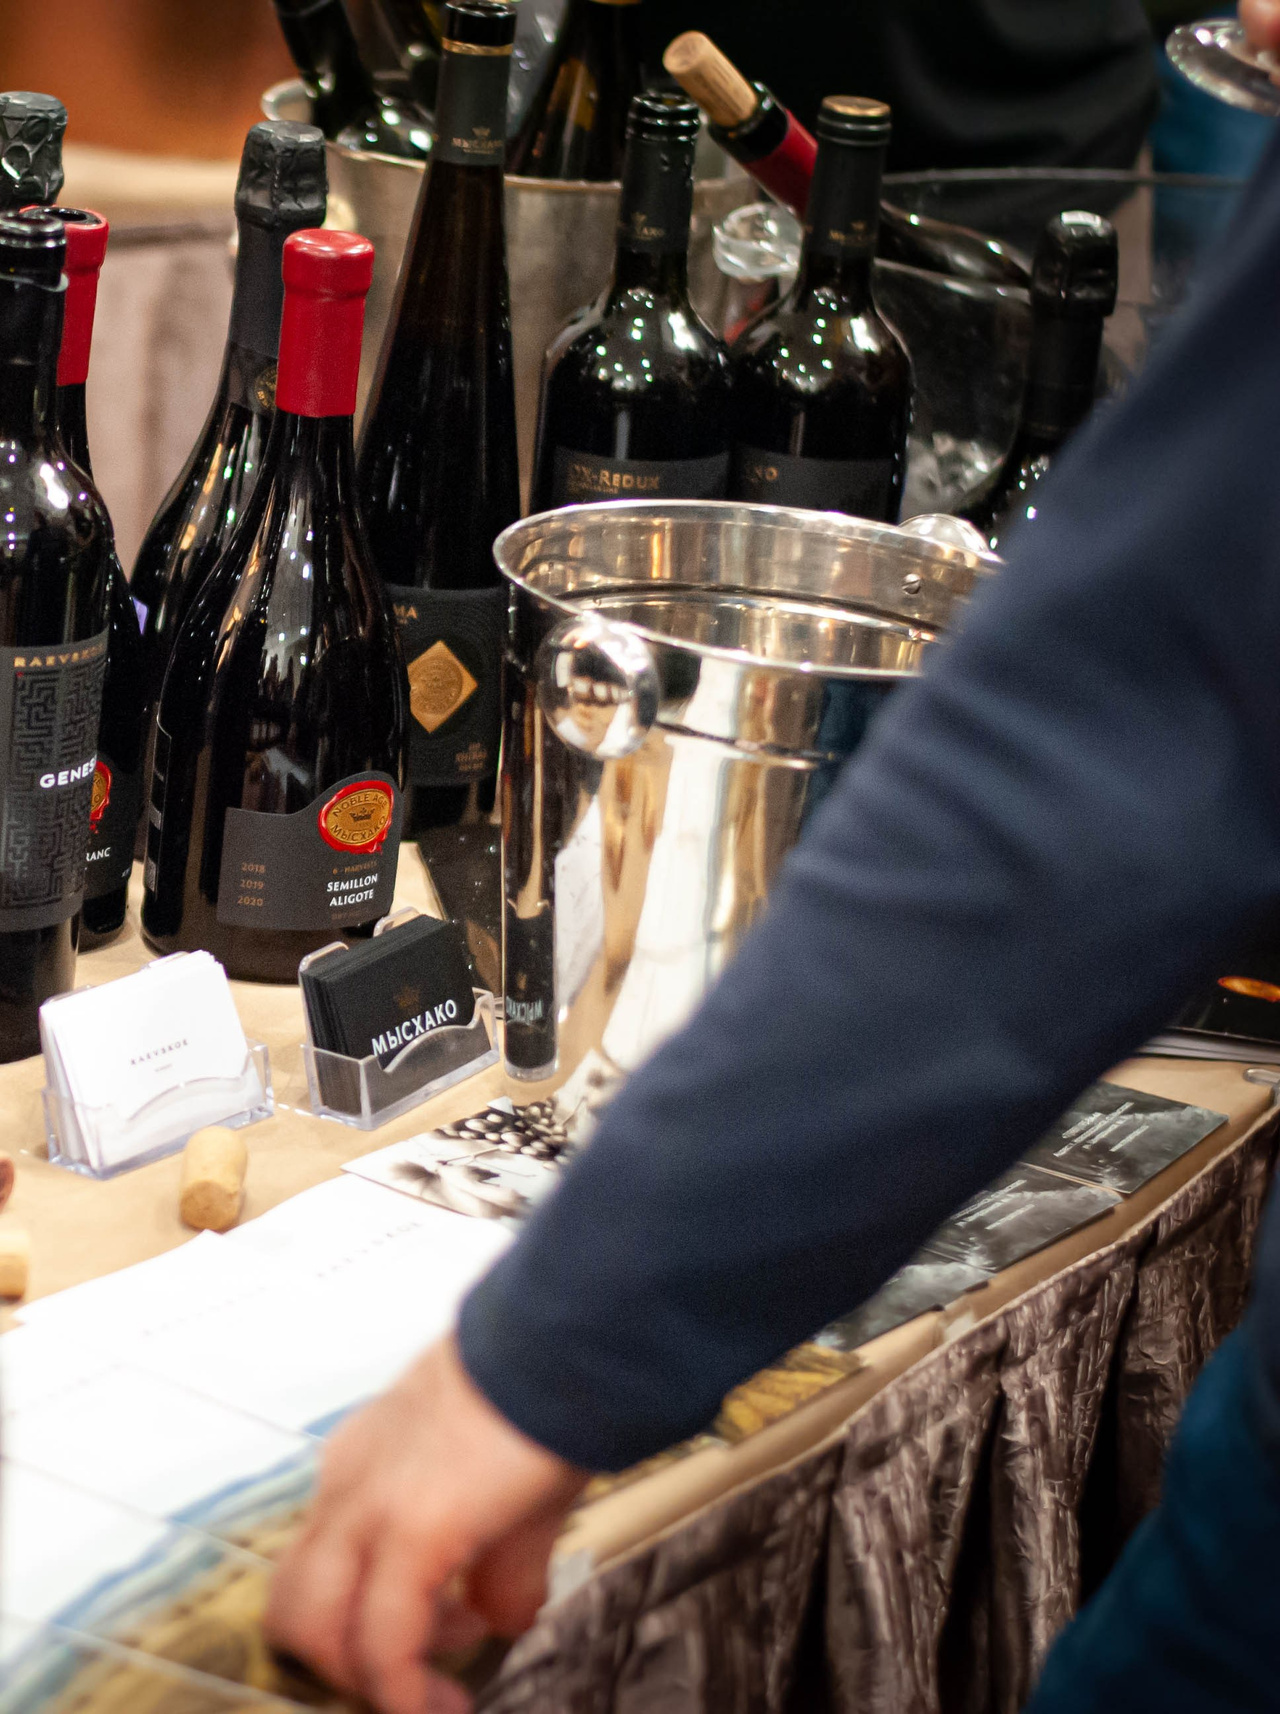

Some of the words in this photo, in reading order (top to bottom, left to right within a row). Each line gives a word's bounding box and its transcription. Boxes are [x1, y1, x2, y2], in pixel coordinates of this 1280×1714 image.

[332, 793, 370, 817] NOBLE
[373, 794, 388, 809] AGE
[330, 815, 386, 842] МЫСХАКО
[241, 862, 266, 874] 2018
[240, 879, 265, 889] 2019
[326, 873, 379, 892] SEMILLON
[237, 896, 264, 907] 2020
[329, 889, 374, 907] ALIGOTE
[371, 999, 457, 1057] МЫСХАКО
